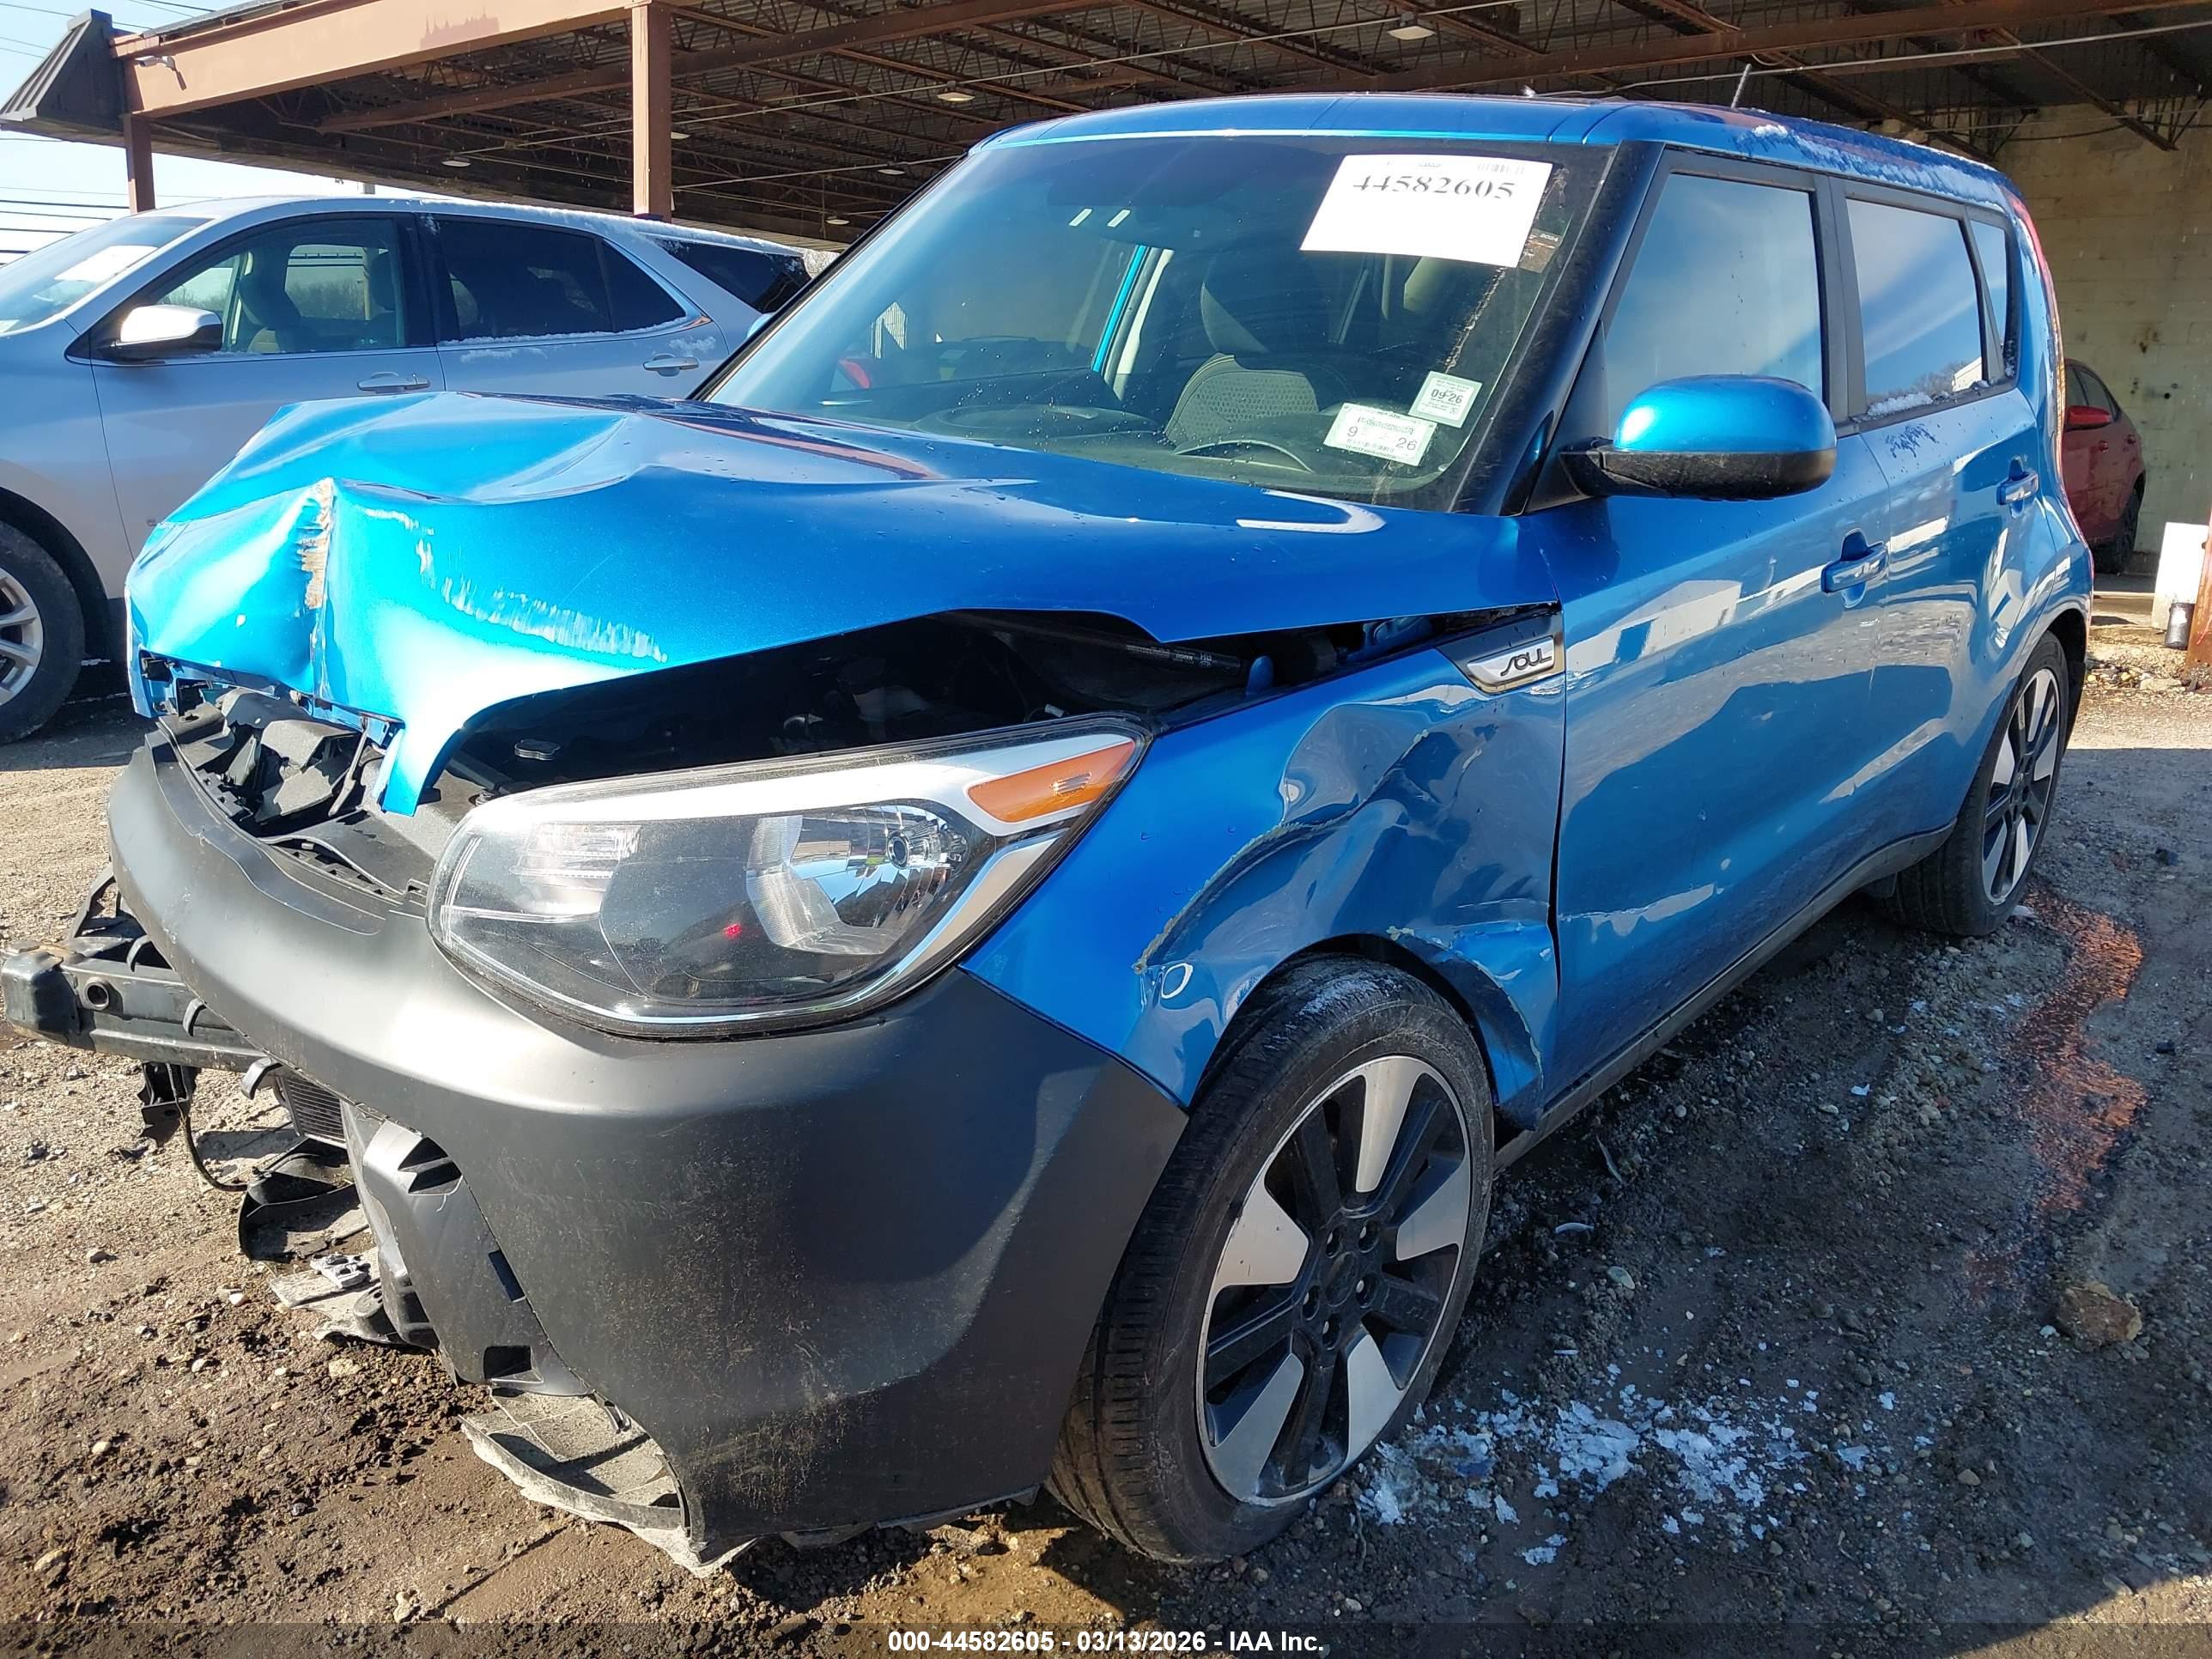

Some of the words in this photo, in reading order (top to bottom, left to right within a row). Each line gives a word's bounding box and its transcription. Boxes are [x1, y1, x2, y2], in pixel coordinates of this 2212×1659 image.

[1353, 174, 1516, 199] 44582605
[1346, 426, 1358, 437] 9
[1395, 437, 1418, 451] 26
[1500, 648, 1553, 677] SOUL
